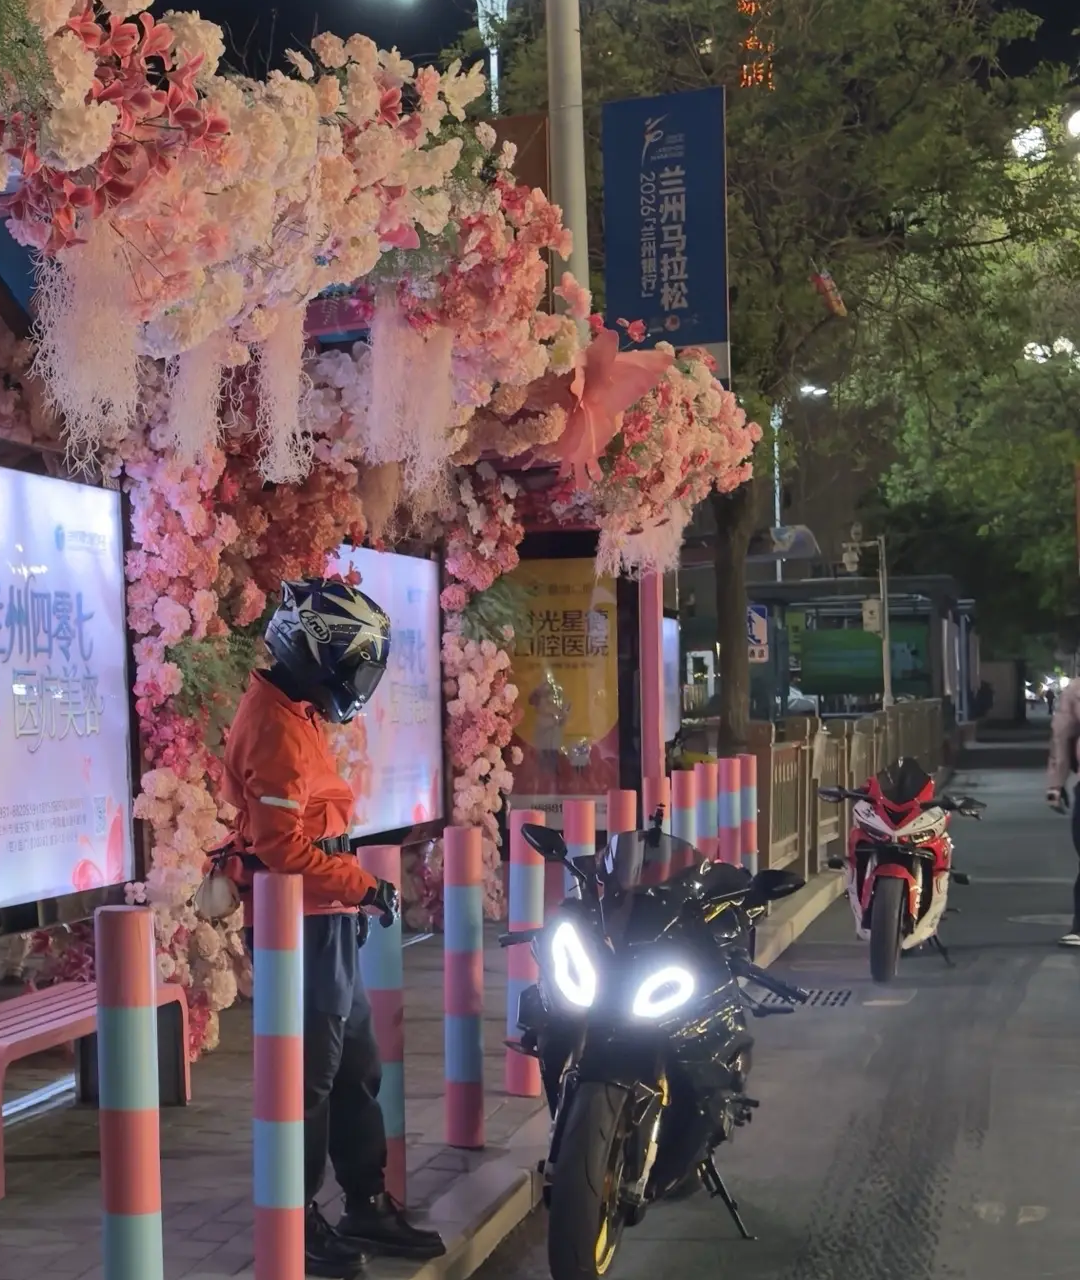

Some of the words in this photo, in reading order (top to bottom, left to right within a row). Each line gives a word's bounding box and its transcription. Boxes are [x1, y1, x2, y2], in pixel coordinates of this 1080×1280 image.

[659, 165, 688, 311] 兰州马拉松
[514, 635, 608, 657] 口腔医院
[12, 665, 105, 754] 医疗美容
